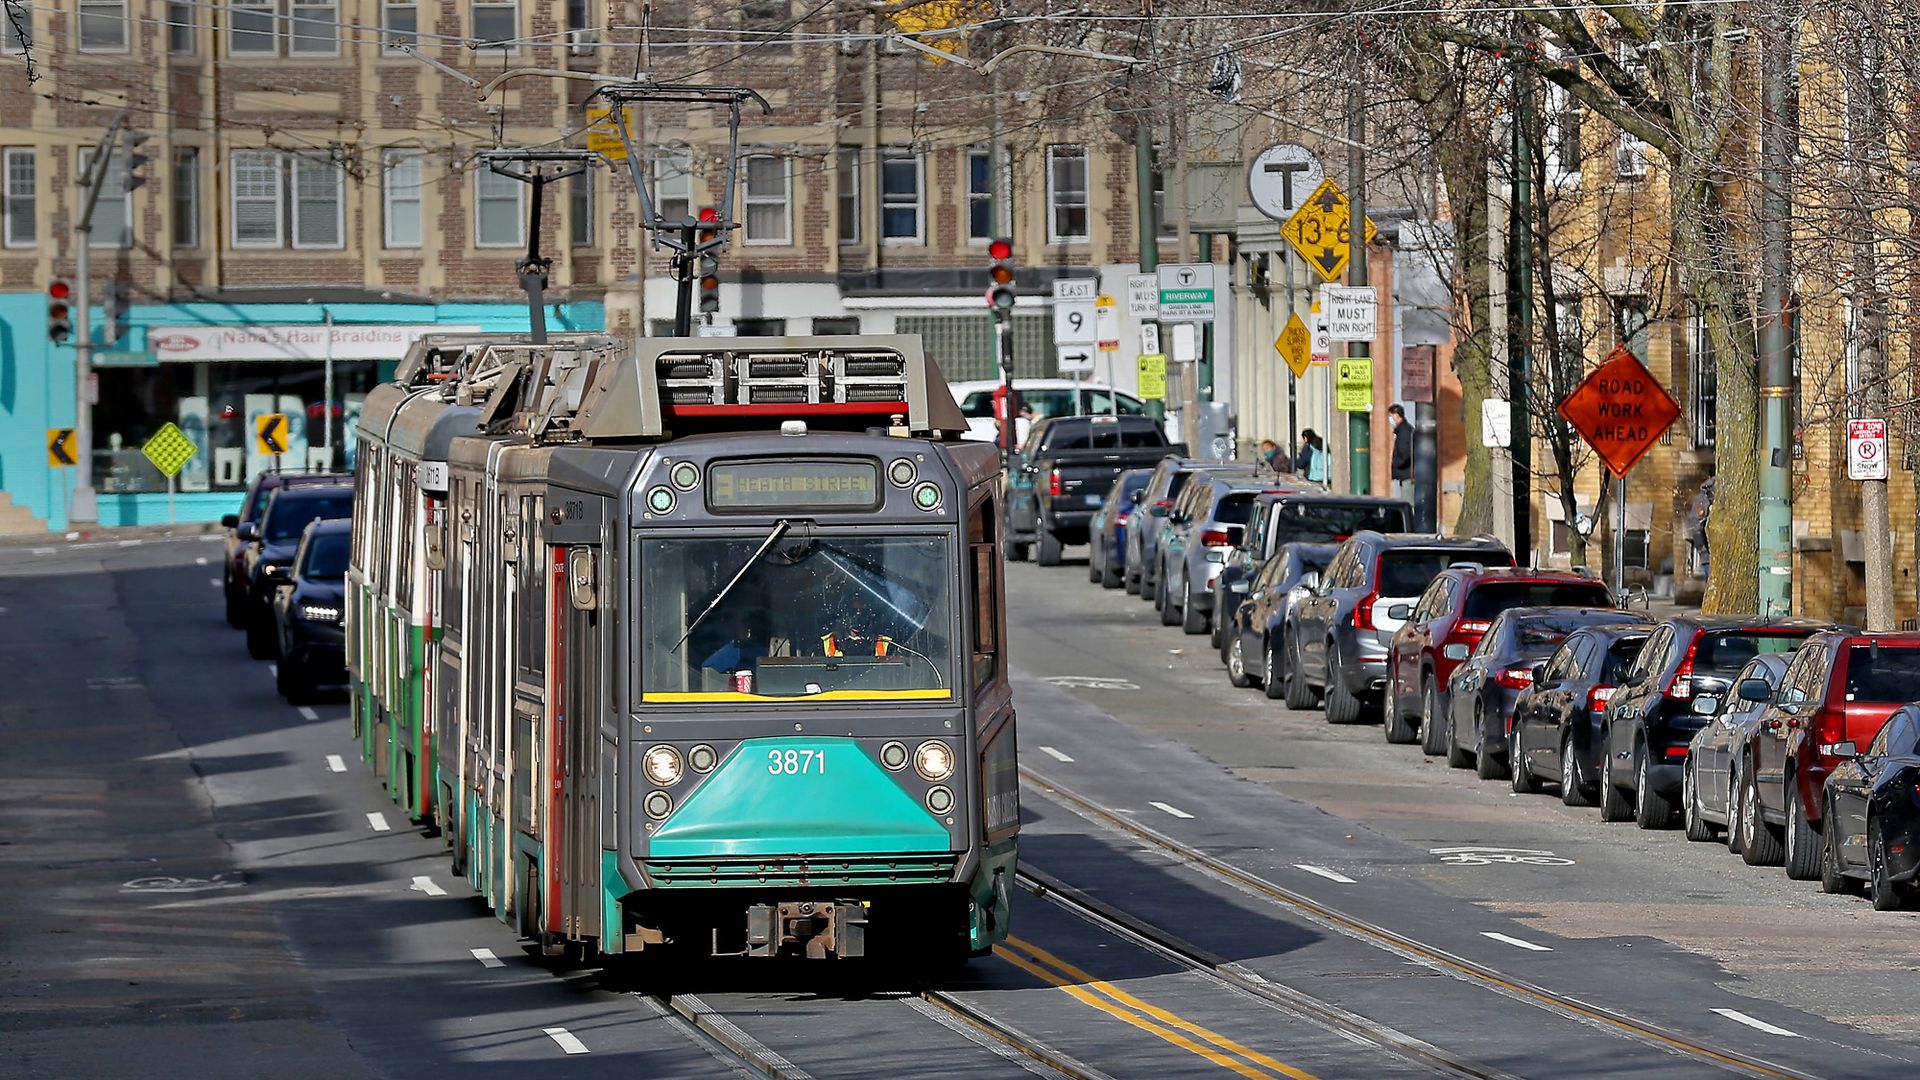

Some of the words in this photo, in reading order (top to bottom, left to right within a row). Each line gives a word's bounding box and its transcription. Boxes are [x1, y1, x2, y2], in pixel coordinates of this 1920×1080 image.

[1264, 162, 1309, 210] T
[1060, 283, 1089, 297] EAST
[1135, 291, 1157, 301] MUS
[1165, 292, 1208, 300] RIVERWAY
[1332, 294, 1352, 304] RIGHT
[1354, 294, 1372, 304] LANE
[1337, 308, 1365, 319] MUST
[1069, 312, 1083, 332] 9
[1332, 322, 1350, 332] TURN
[1352, 322, 1372, 332] RIGHT
[287, 331, 322, 343] Hair
[330, 330, 402, 343] Braiding
[1599, 380, 1644, 394] ROAD
[1598, 403, 1643, 417] WORK
[1593, 426, 1648, 440] AHEAD
[738, 477, 793, 491] HEATH
[805, 476, 870, 491] STREET
[767, 749, 825, 775] 3871
